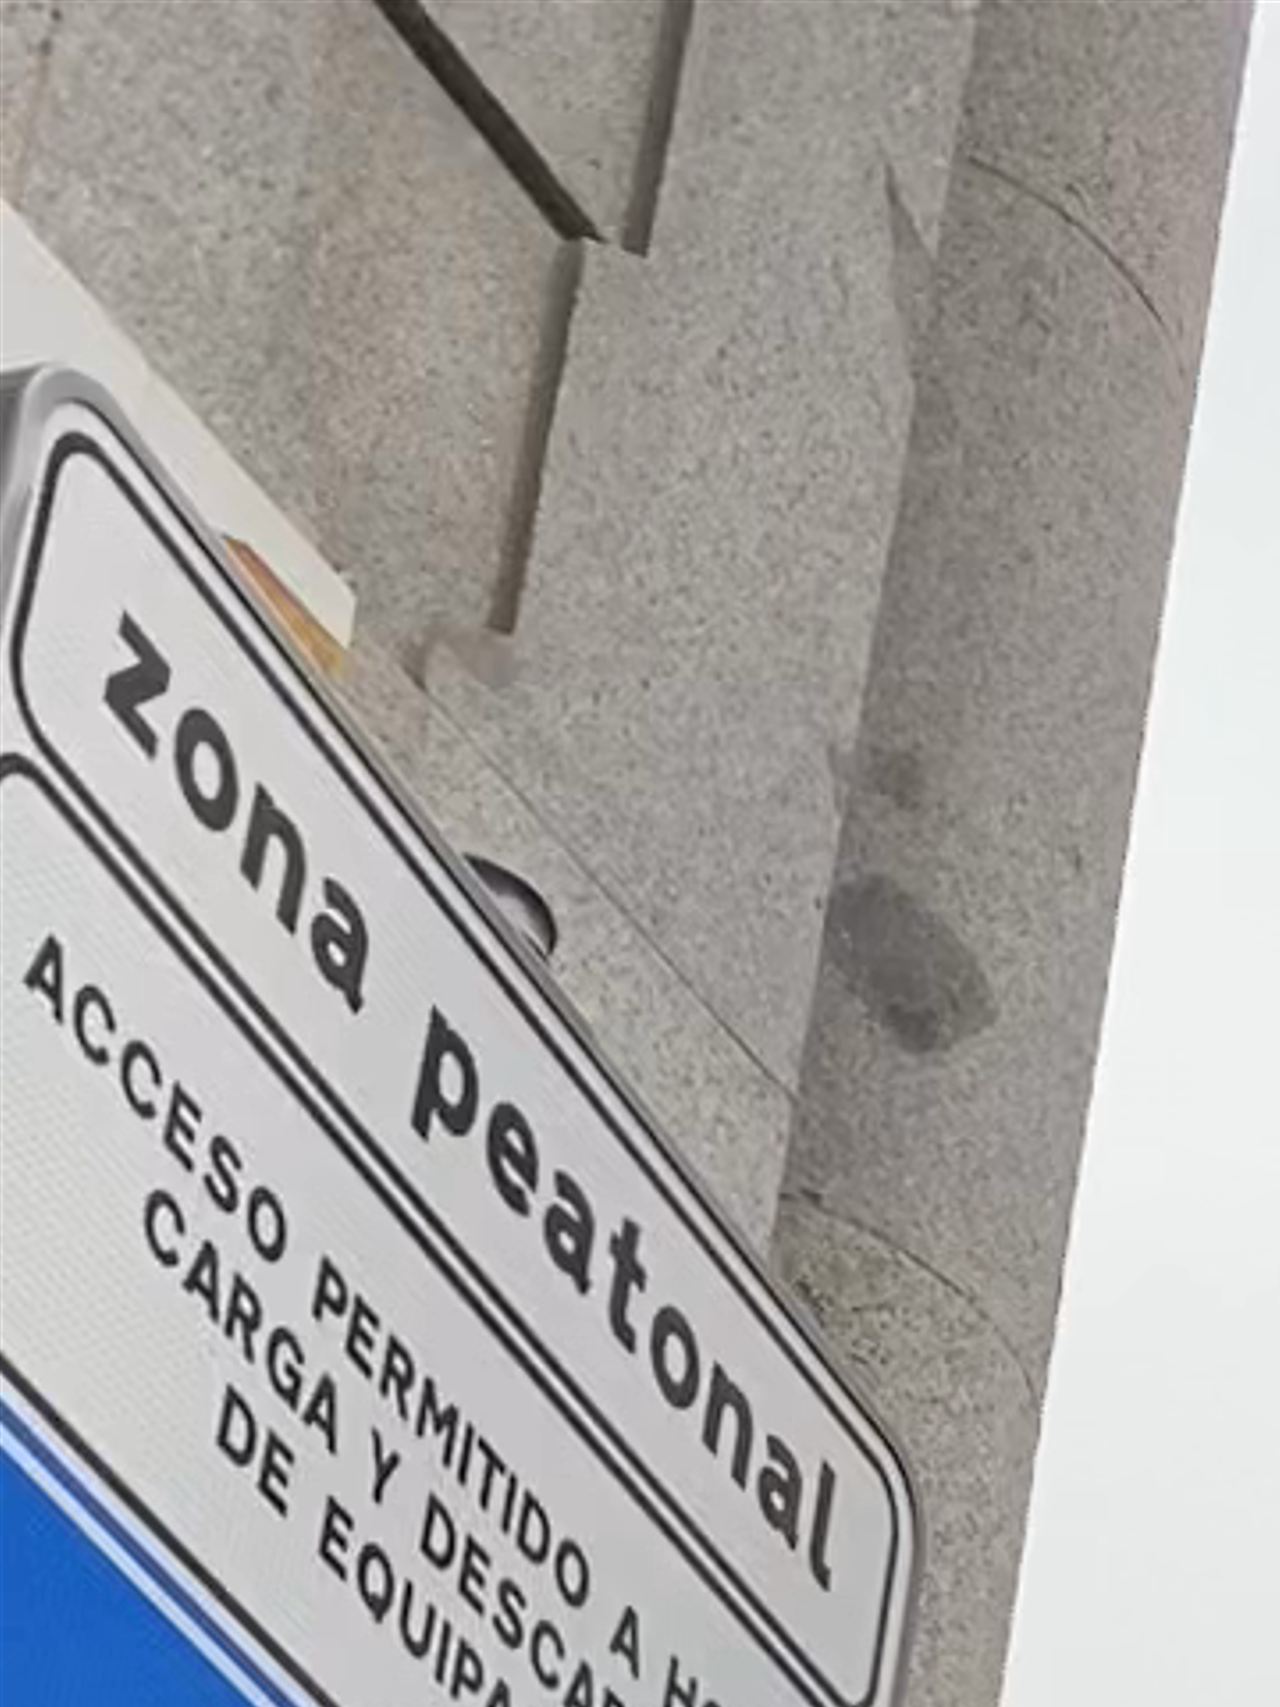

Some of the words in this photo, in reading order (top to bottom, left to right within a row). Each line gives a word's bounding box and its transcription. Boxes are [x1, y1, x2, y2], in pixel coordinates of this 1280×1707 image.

[22, 934, 289, 1265] ACCESO
[310, 1254, 592, 1611] PERMITIDO
[607, 1603, 642, 1682] A
[102, 610, 371, 1017] zona
[409, 1003, 838, 1594] peatonal
[142, 1187, 339, 1457] CARGA
[369, 1426, 403, 1506] Y
[214, 1382, 297, 1520] DE
